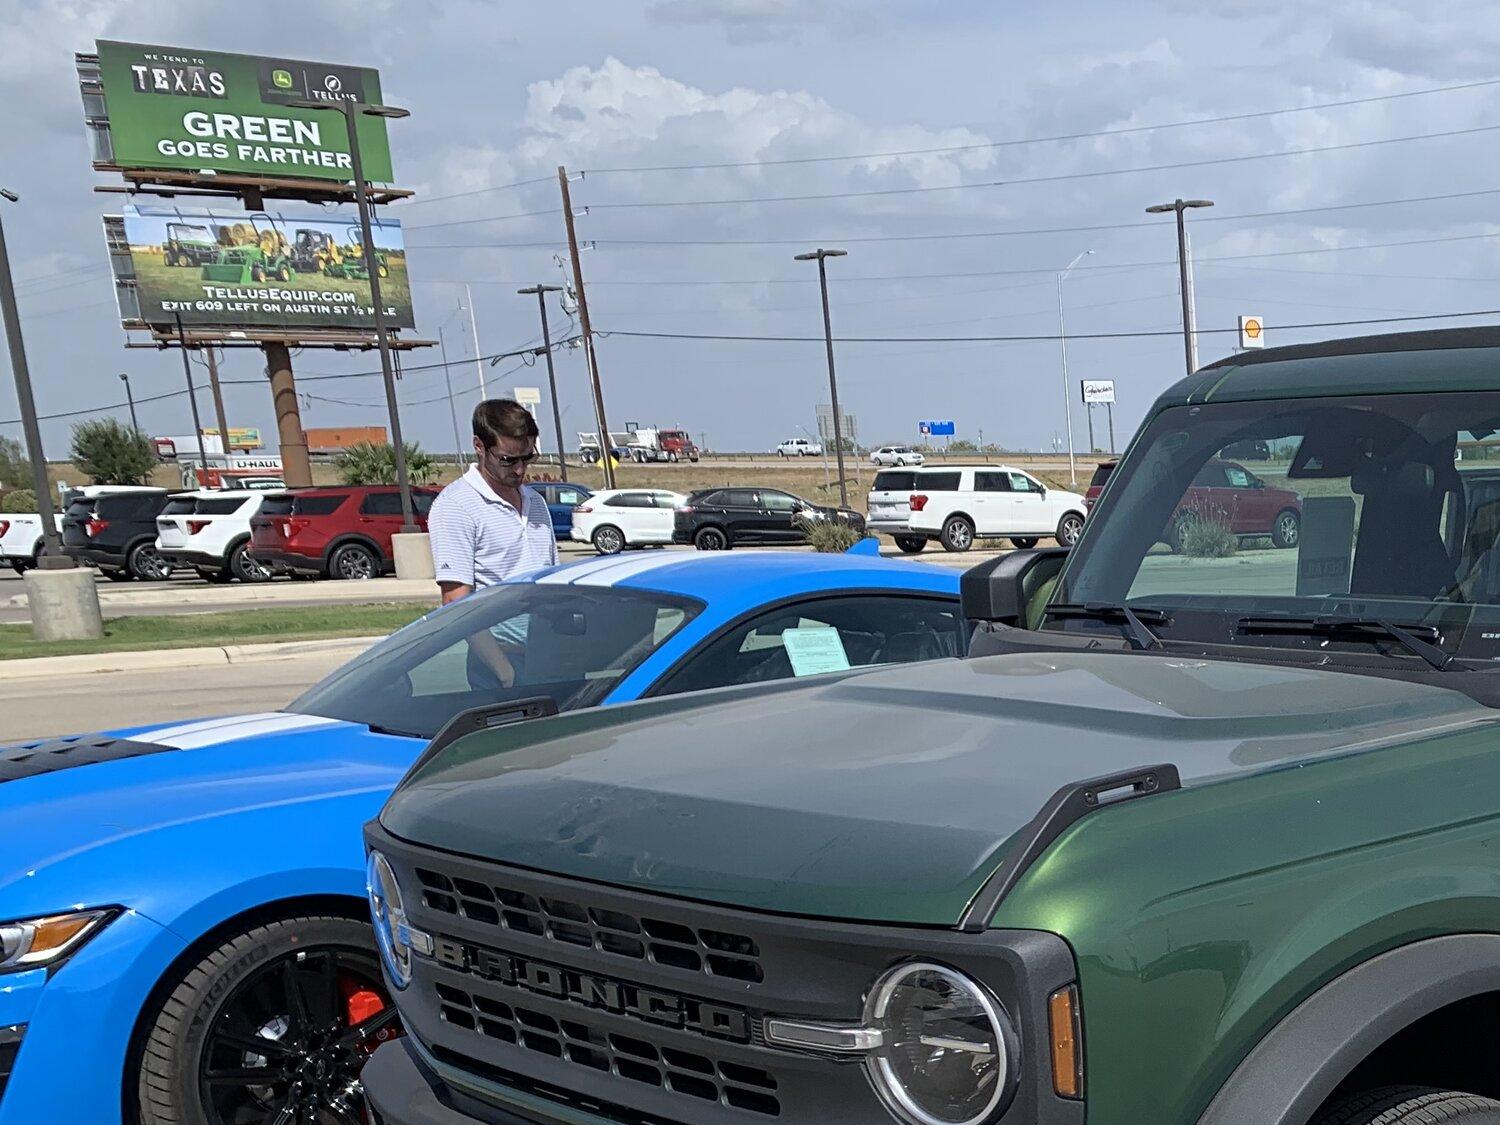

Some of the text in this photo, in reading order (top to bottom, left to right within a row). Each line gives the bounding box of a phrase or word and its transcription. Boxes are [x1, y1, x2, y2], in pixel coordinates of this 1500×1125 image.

[162, 55, 188, 63] TEND
[131, 64, 226, 95] TEXAS
[183, 111, 322, 146] GREEN
[157, 139, 352, 169] GOES FARTHER
[161, 300, 192, 311] EXIT
[195, 300, 224, 311] 609
[226, 301, 260, 312] LEFT
[262, 303, 281, 313] ON
[284, 303, 331, 314] AUSTIN
[333, 305, 349, 315] ST
[367, 306, 397, 316] MLE
[434, 936, 749, 1040] BRONCO
